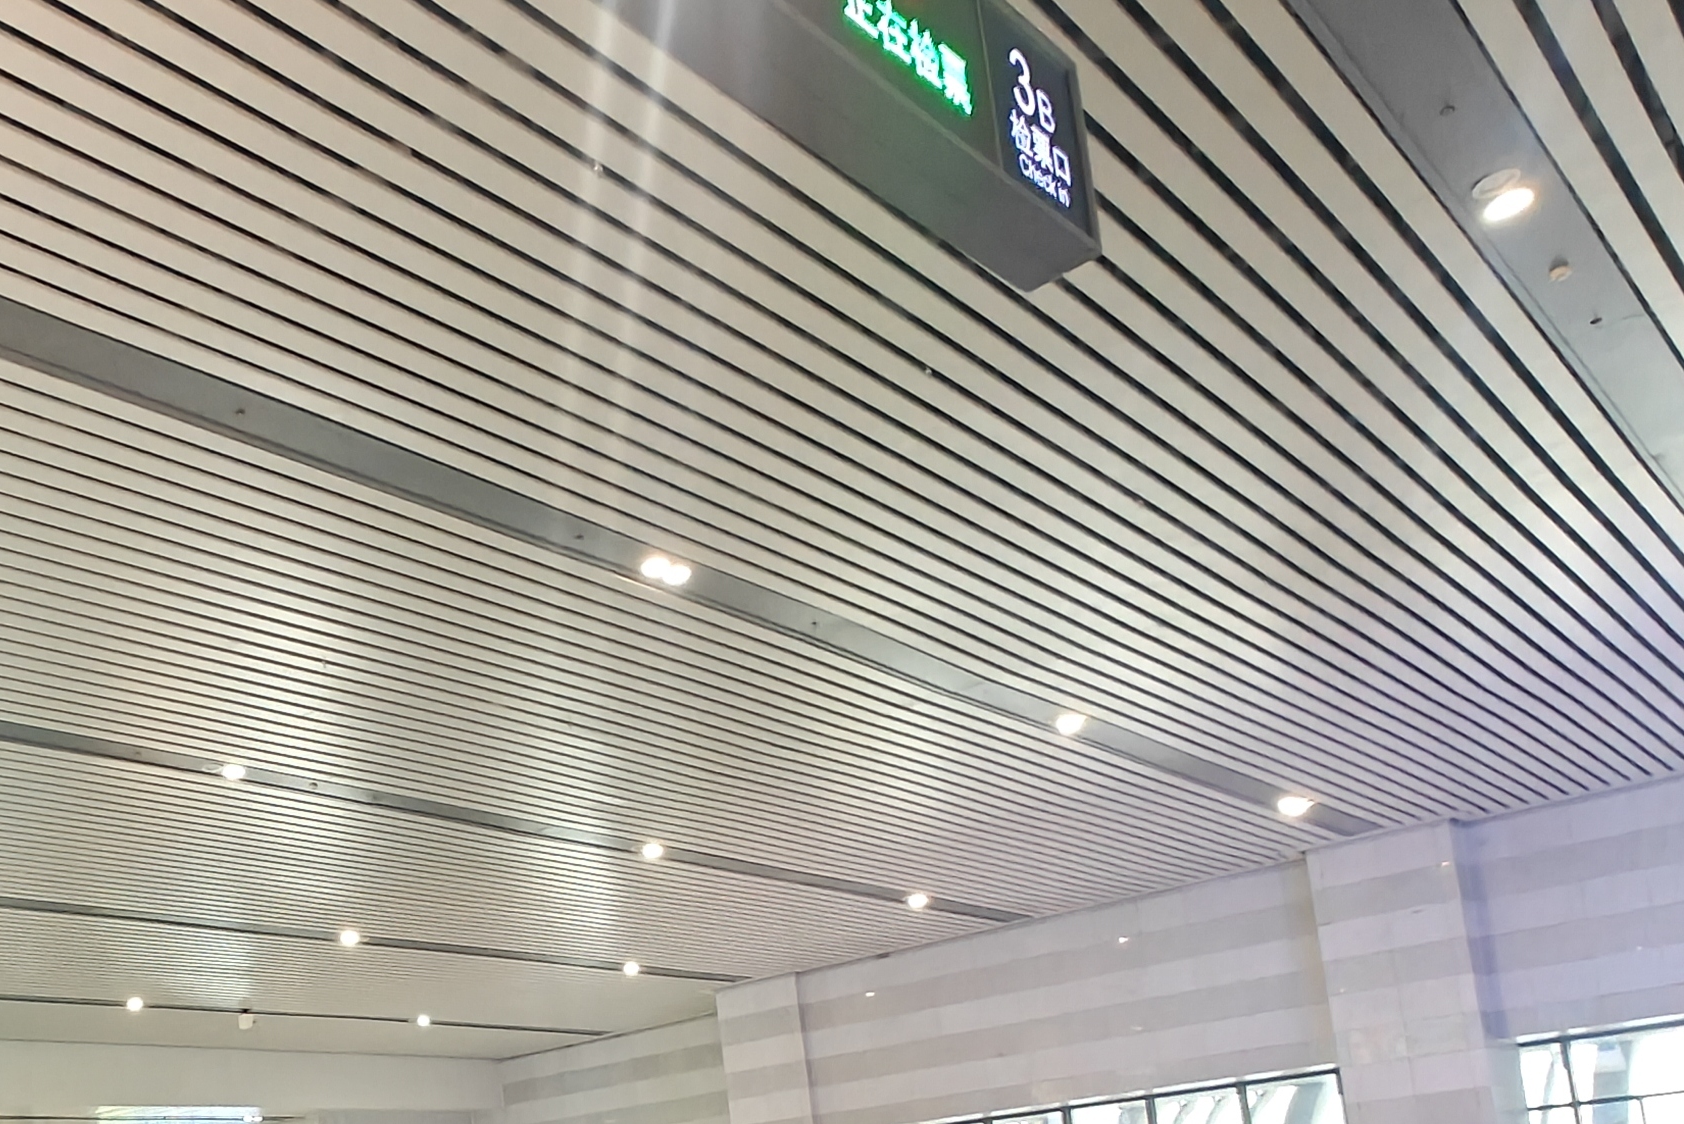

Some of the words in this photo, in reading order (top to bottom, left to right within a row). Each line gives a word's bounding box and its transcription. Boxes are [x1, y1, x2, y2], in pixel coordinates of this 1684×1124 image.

[1009, 108, 1072, 186] 检票口
[1018, 153, 1059, 201] Check
